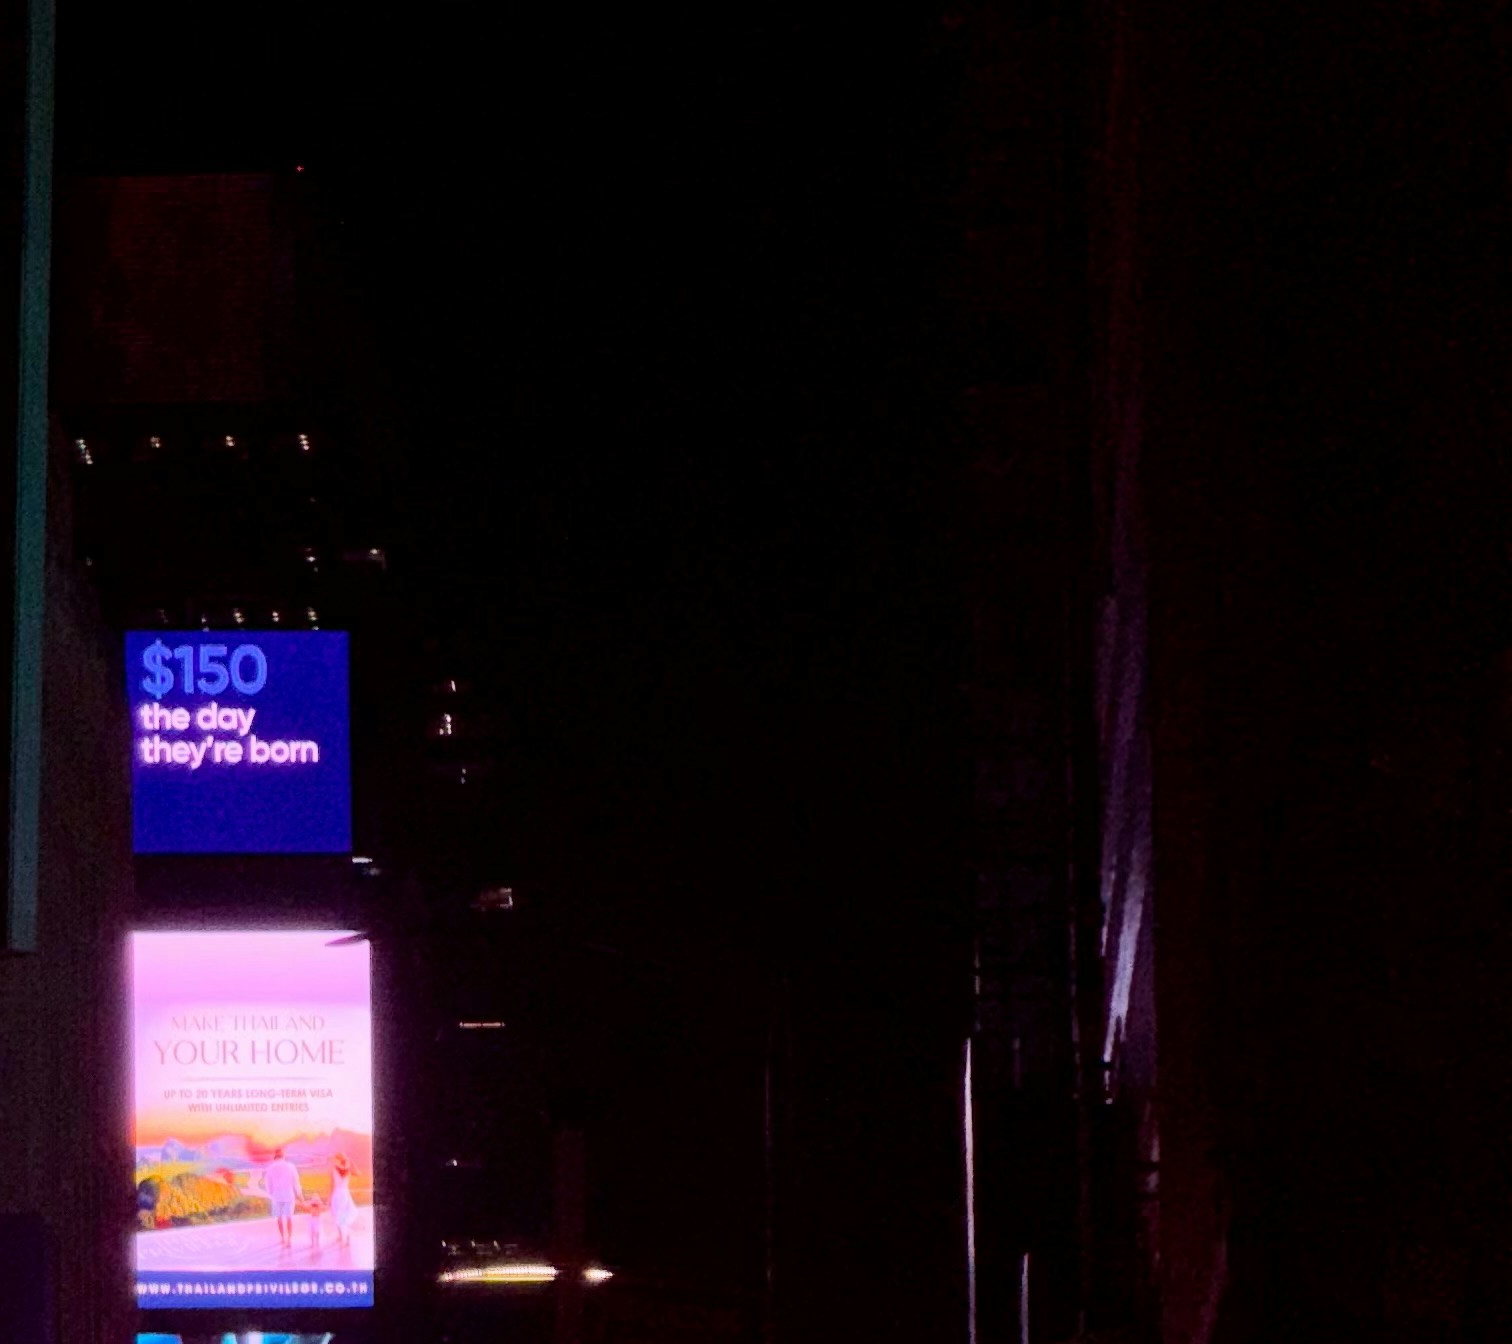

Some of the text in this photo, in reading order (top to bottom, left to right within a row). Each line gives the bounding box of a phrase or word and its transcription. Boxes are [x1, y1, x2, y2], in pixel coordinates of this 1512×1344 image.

[141, 638, 269, 700] $150
[140, 702, 256, 736] the day
[140, 734, 320, 770] they're born
[233, 1014, 326, 1032] THAILAND
[153, 1039, 346, 1066] YOUR HOME
